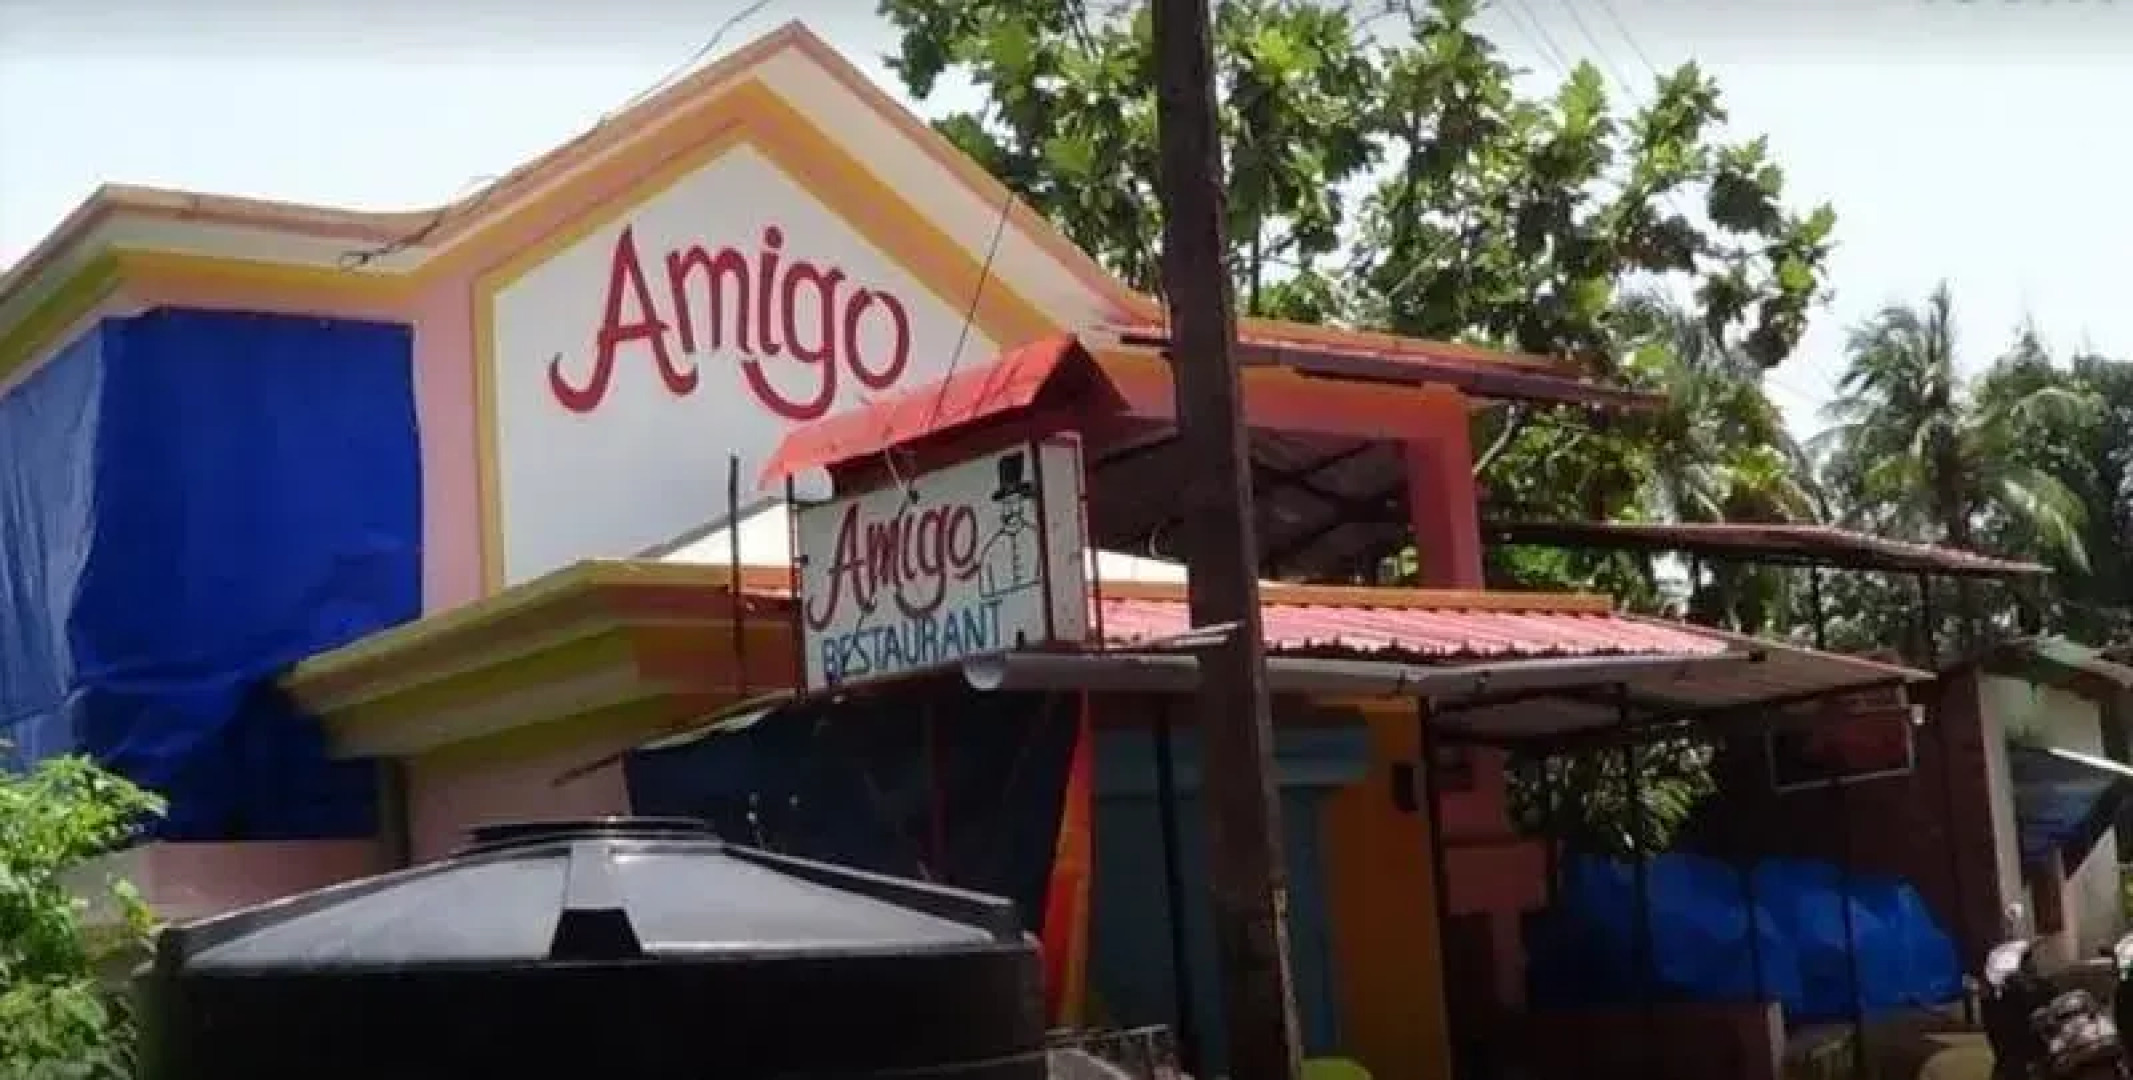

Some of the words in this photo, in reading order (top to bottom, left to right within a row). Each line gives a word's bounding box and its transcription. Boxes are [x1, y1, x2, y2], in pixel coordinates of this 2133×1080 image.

[548, 223, 911, 421] Amigo
[807, 502, 982, 632] Amigo
[823, 600, 1003, 684] RESTAURANT
